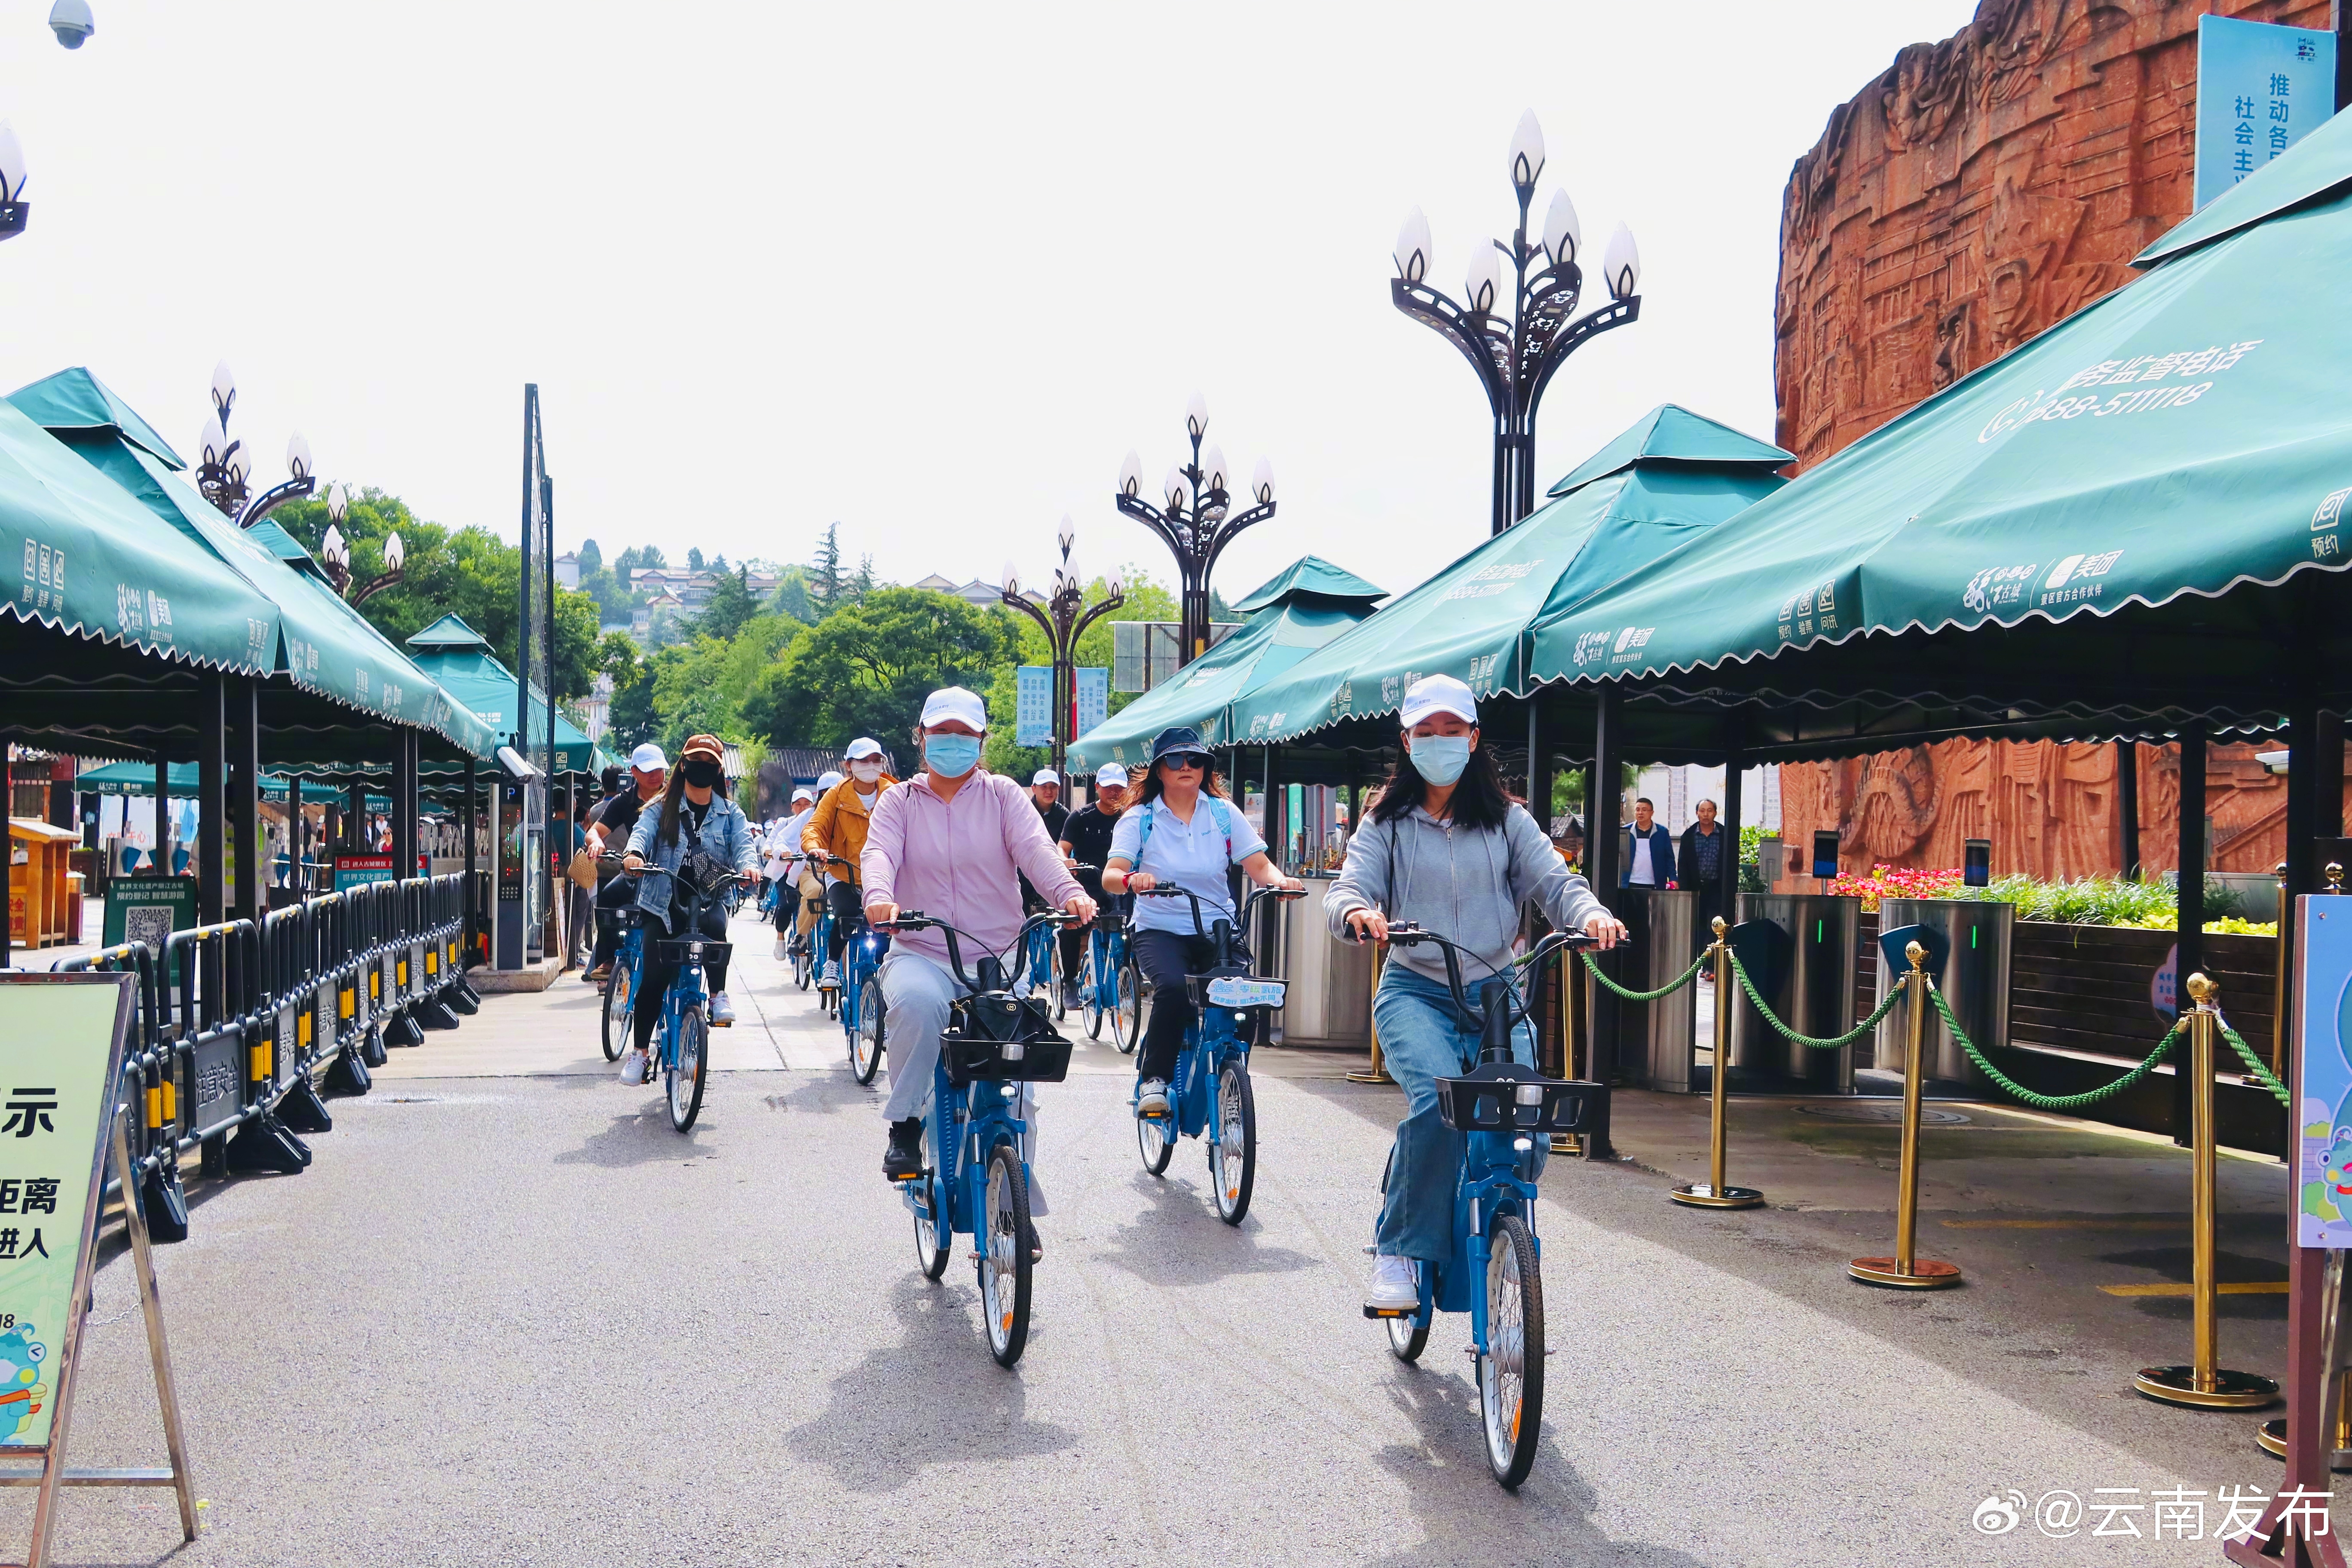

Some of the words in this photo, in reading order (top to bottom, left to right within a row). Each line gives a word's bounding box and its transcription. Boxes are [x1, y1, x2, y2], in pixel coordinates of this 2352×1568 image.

[2311, 533, 2339, 558] 预约
[2071, 549, 2125, 580] 美团
[2040, 583, 2103, 606] 景区官方合作伙伴
[1798, 619, 1813, 636] 验票
[1820, 614, 1838, 631] 问讯
[1627, 627, 1656, 648] 美团
[1778, 624, 1792, 640] 预约
[507, 787, 515, 800] P
[116, 891, 150, 900] 预约登记
[152, 891, 185, 900] 智慧游园
[1240, 984, 1282, 994] 零碳氢旅
[1213, 995, 1237, 1004] 共享出行
[1240, 994, 1276, 1004] 丽江大不同
[196, 1056, 239, 1108] 注意安全
[1, 1088, 58, 1138] 示
